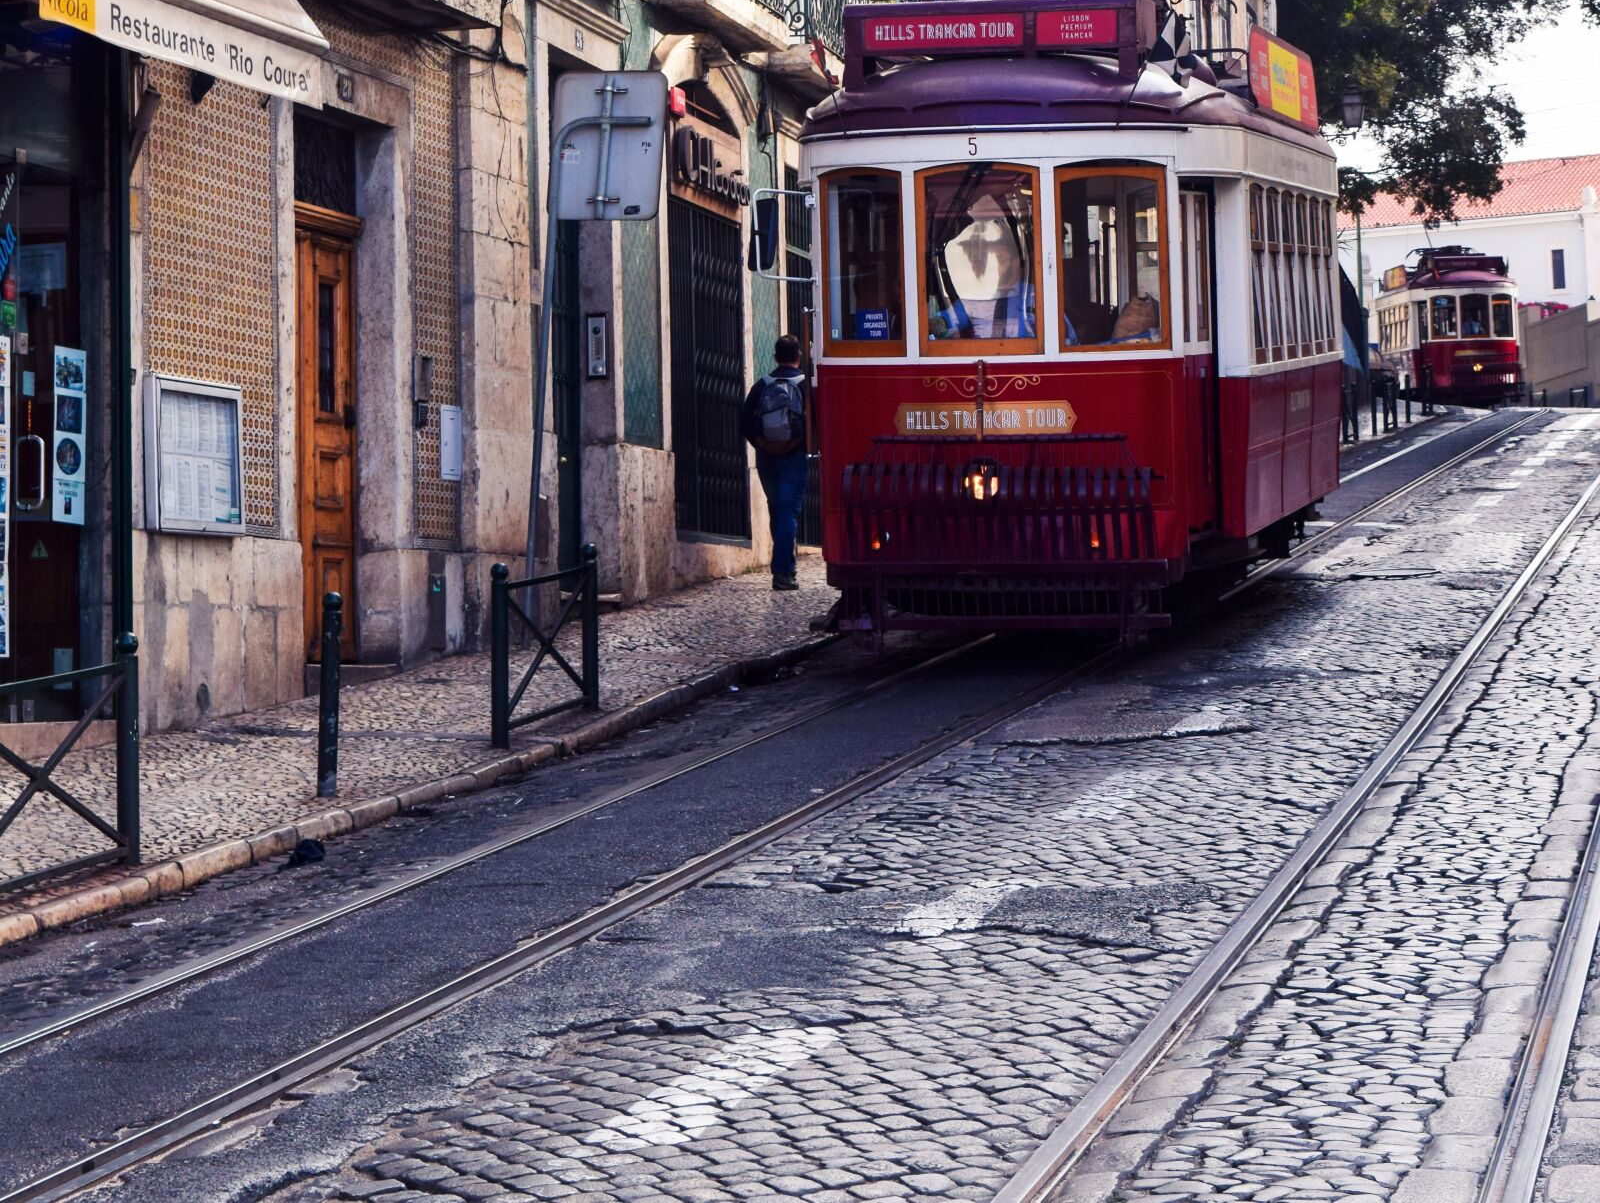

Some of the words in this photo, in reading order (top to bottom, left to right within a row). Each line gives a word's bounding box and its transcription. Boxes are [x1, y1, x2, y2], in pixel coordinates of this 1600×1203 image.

[1060, 23, 1093, 31] PREMIUM
[1063, 14, 1090, 22] LISBON
[110, 2, 215, 63] Restaurante
[875, 24, 915, 41] HILLS
[918, 22, 976, 40] TRAMCAR
[979, 22, 1015, 38] TOUR
[1060, 31, 1093, 40] TRAMCAR
[968, 137, 977, 156] 5
[0, 172, 15, 218] ante
[863, 321, 887, 329] ORGANIZED
[906, 411, 949, 430] HILLS
[1025, 408, 1067, 428] TOUR
